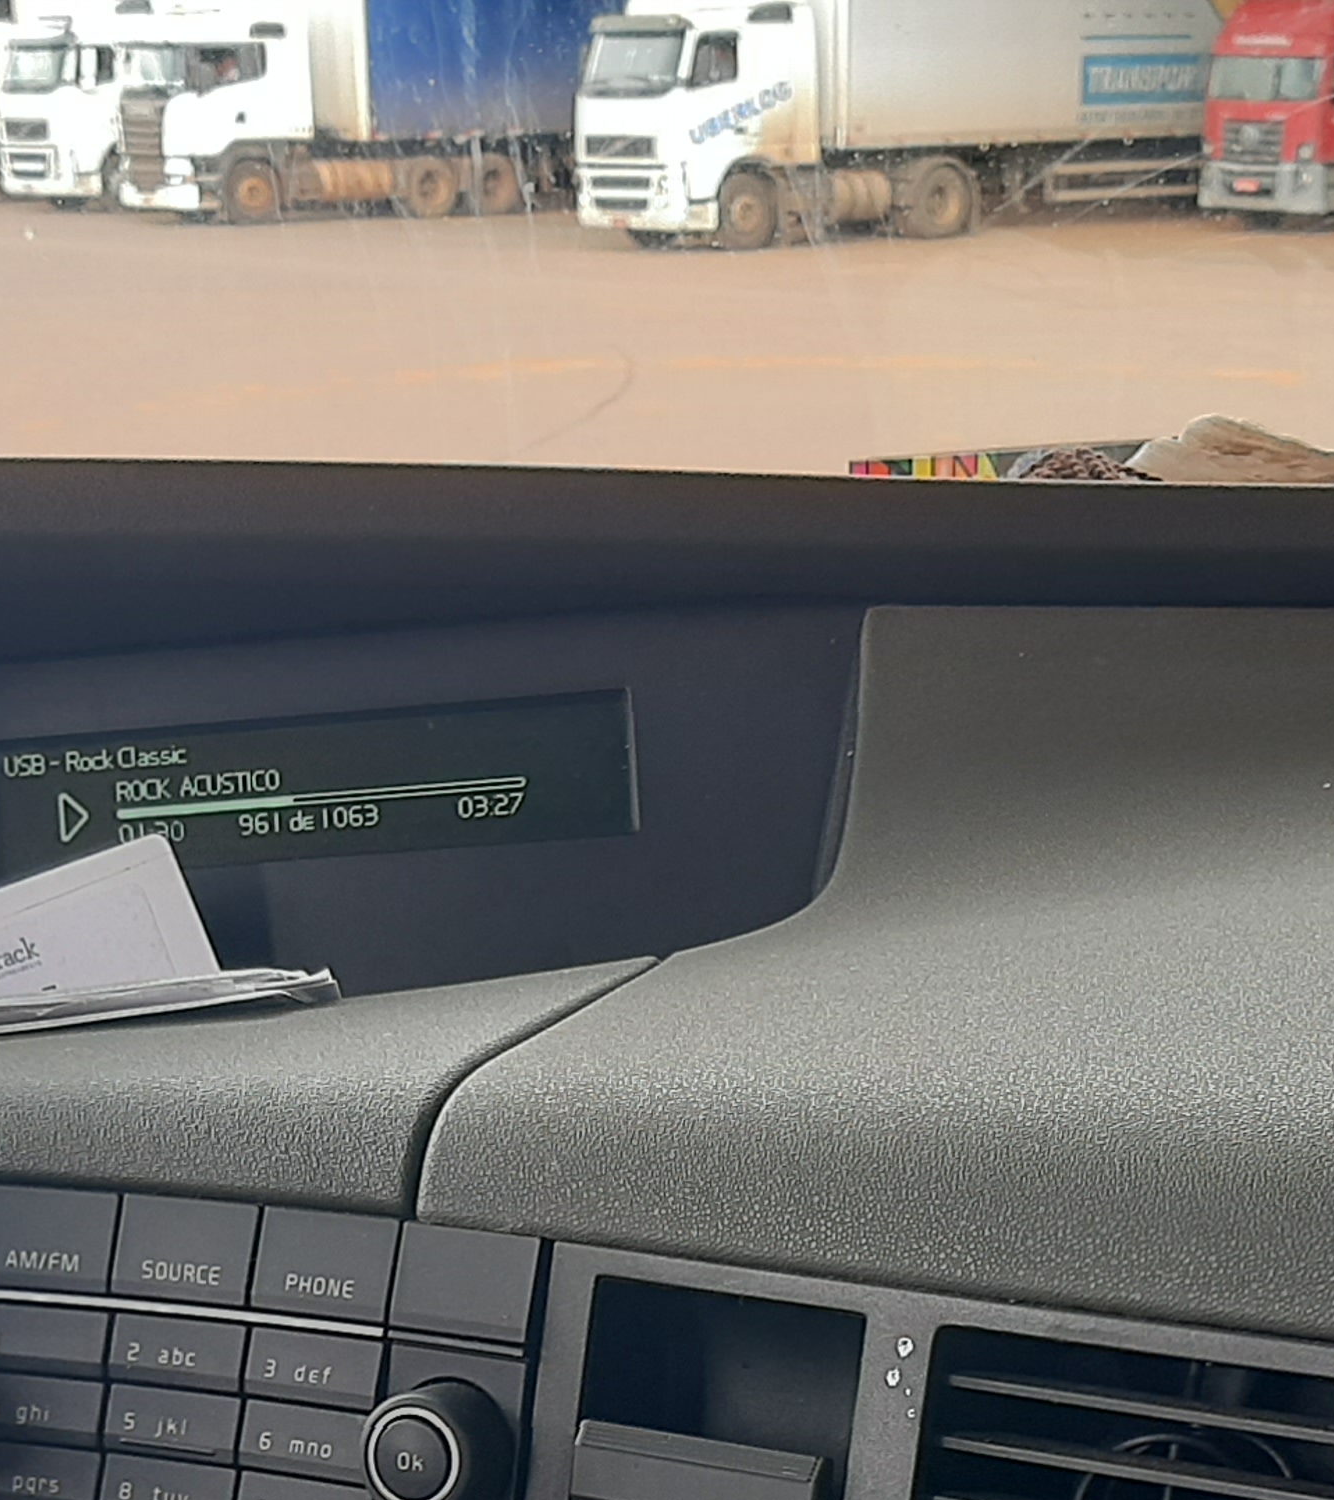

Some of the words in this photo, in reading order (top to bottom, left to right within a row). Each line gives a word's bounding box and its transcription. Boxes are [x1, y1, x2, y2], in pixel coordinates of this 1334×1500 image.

[3, 753, 46, 778] USB
[65, 748, 114, 774] Rock
[116, 744, 188, 769] Classic
[115, 777, 171, 803] ROCK
[179, 768, 281, 798] ACUSTICO
[456, 792, 525, 820] 03:27
[237, 813, 281, 837] 961
[288, 810, 316, 832] de
[321, 804, 380, 829] 1063
[4, 1249, 81, 1273] AM/FM
[140, 1259, 222, 1286] SOURCE
[284, 1272, 356, 1299] PHONE
[125, 1341, 142, 1362] 2
[157, 1346, 197, 1367] abc
[263, 1358, 278, 1379] 3
[293, 1363, 333, 1386] def
[14, 1403, 51, 1426] ghi
[123, 1411, 136, 1430] 5
[154, 1416, 188, 1438] jkl
[258, 1431, 272, 1451] 6
[288, 1438, 333, 1459] mno
[396, 1451, 424, 1472] Ok
[11, 1474, 60, 1495] pqrs
[118, 1481, 133, 1500] 8
